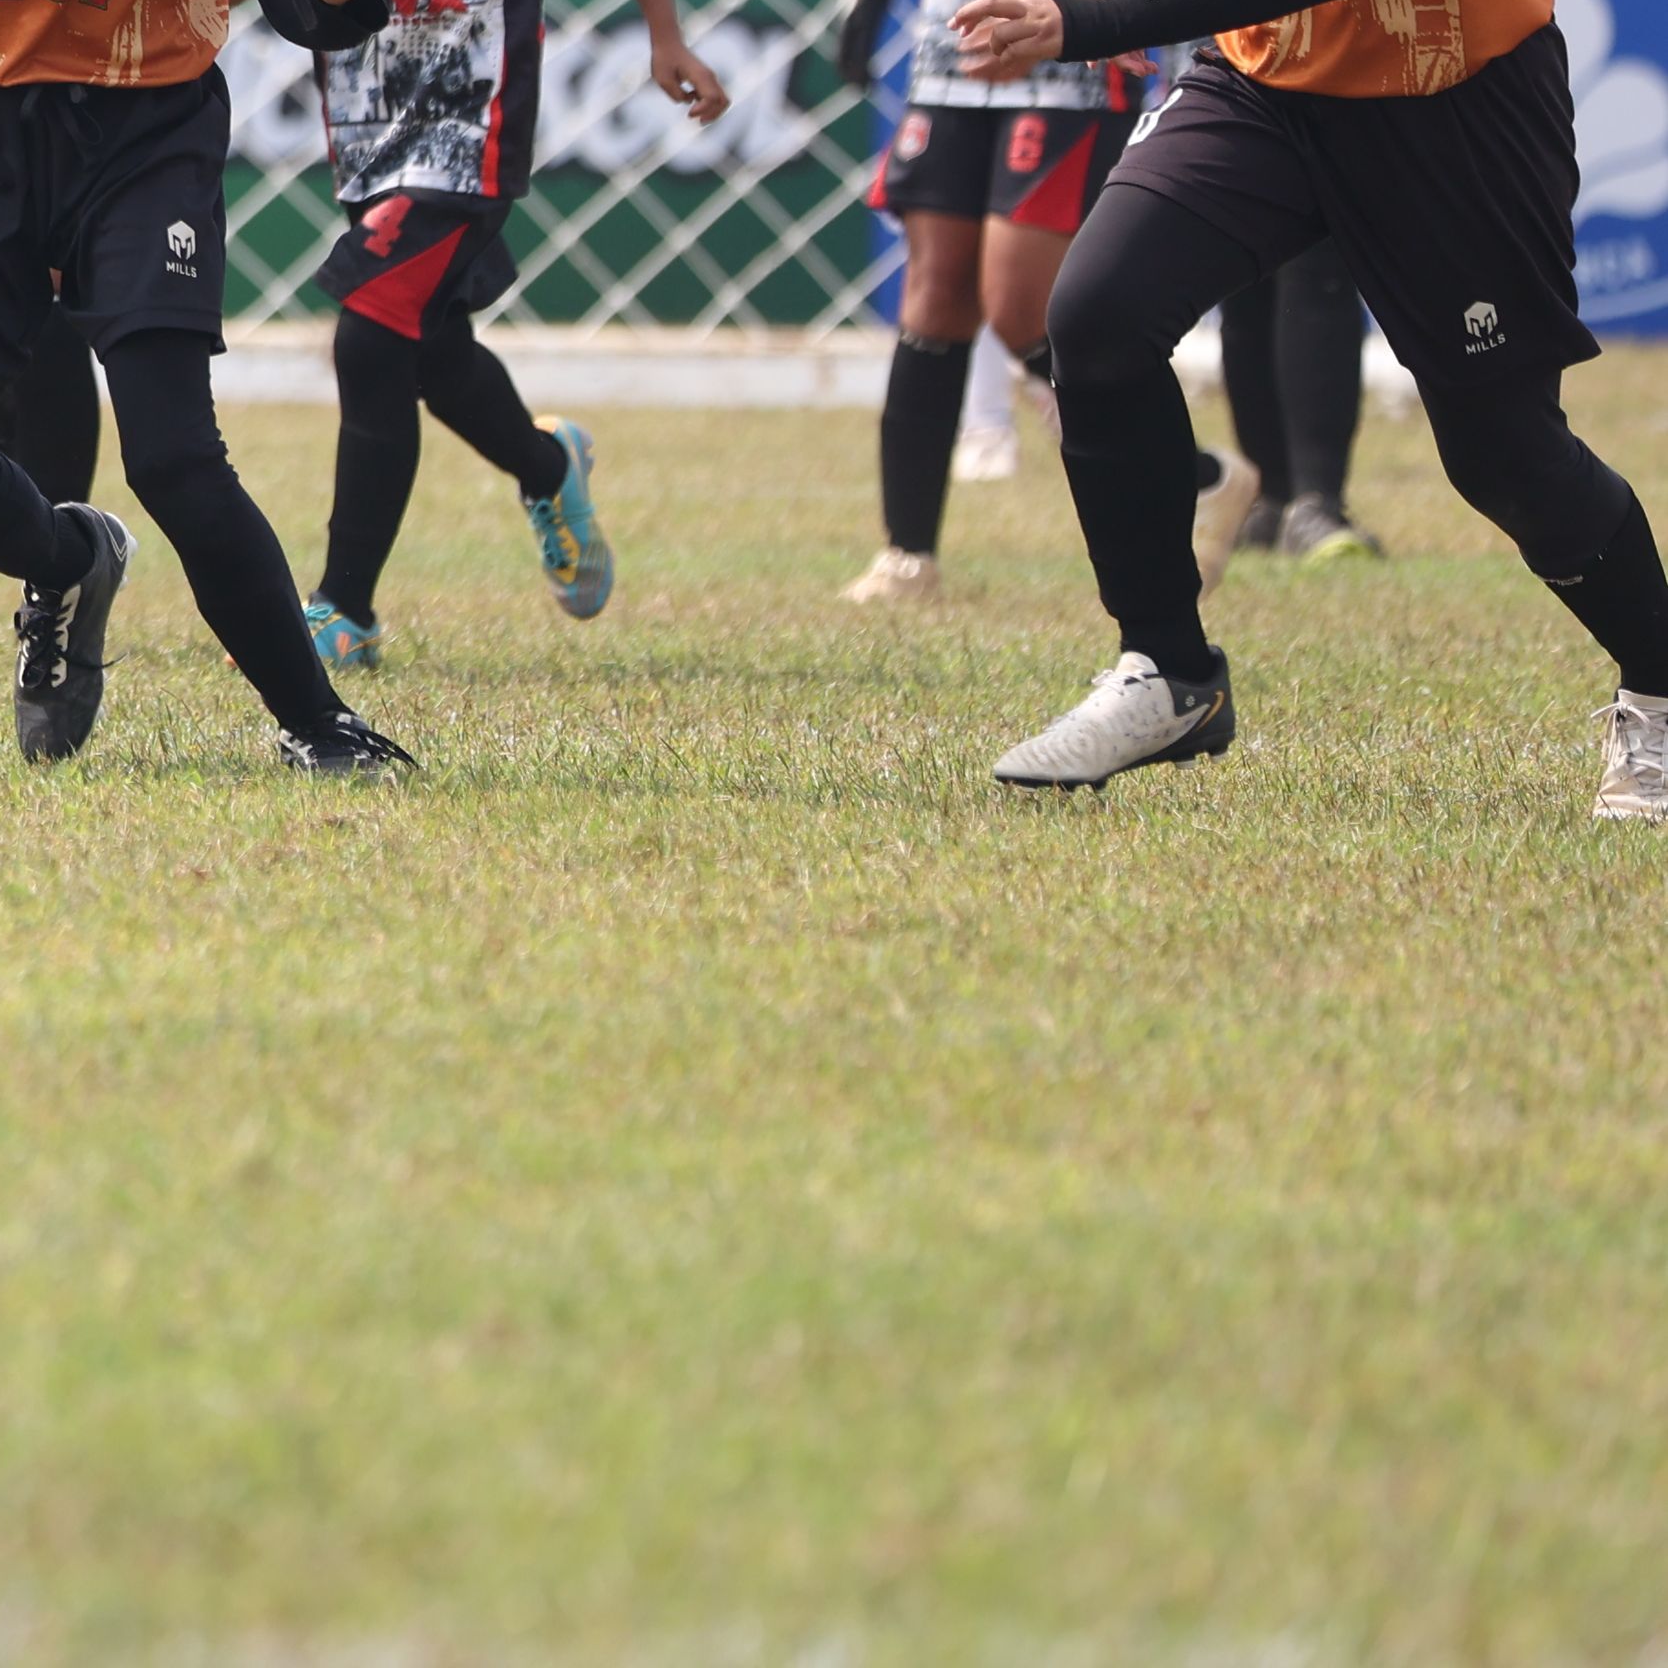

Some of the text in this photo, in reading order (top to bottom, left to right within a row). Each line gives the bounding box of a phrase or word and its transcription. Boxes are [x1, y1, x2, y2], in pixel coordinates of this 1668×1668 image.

[361, 193, 413, 259] 4
[166, 261, 198, 279] MILLS
[1465, 333, 1506, 355] MILLS
